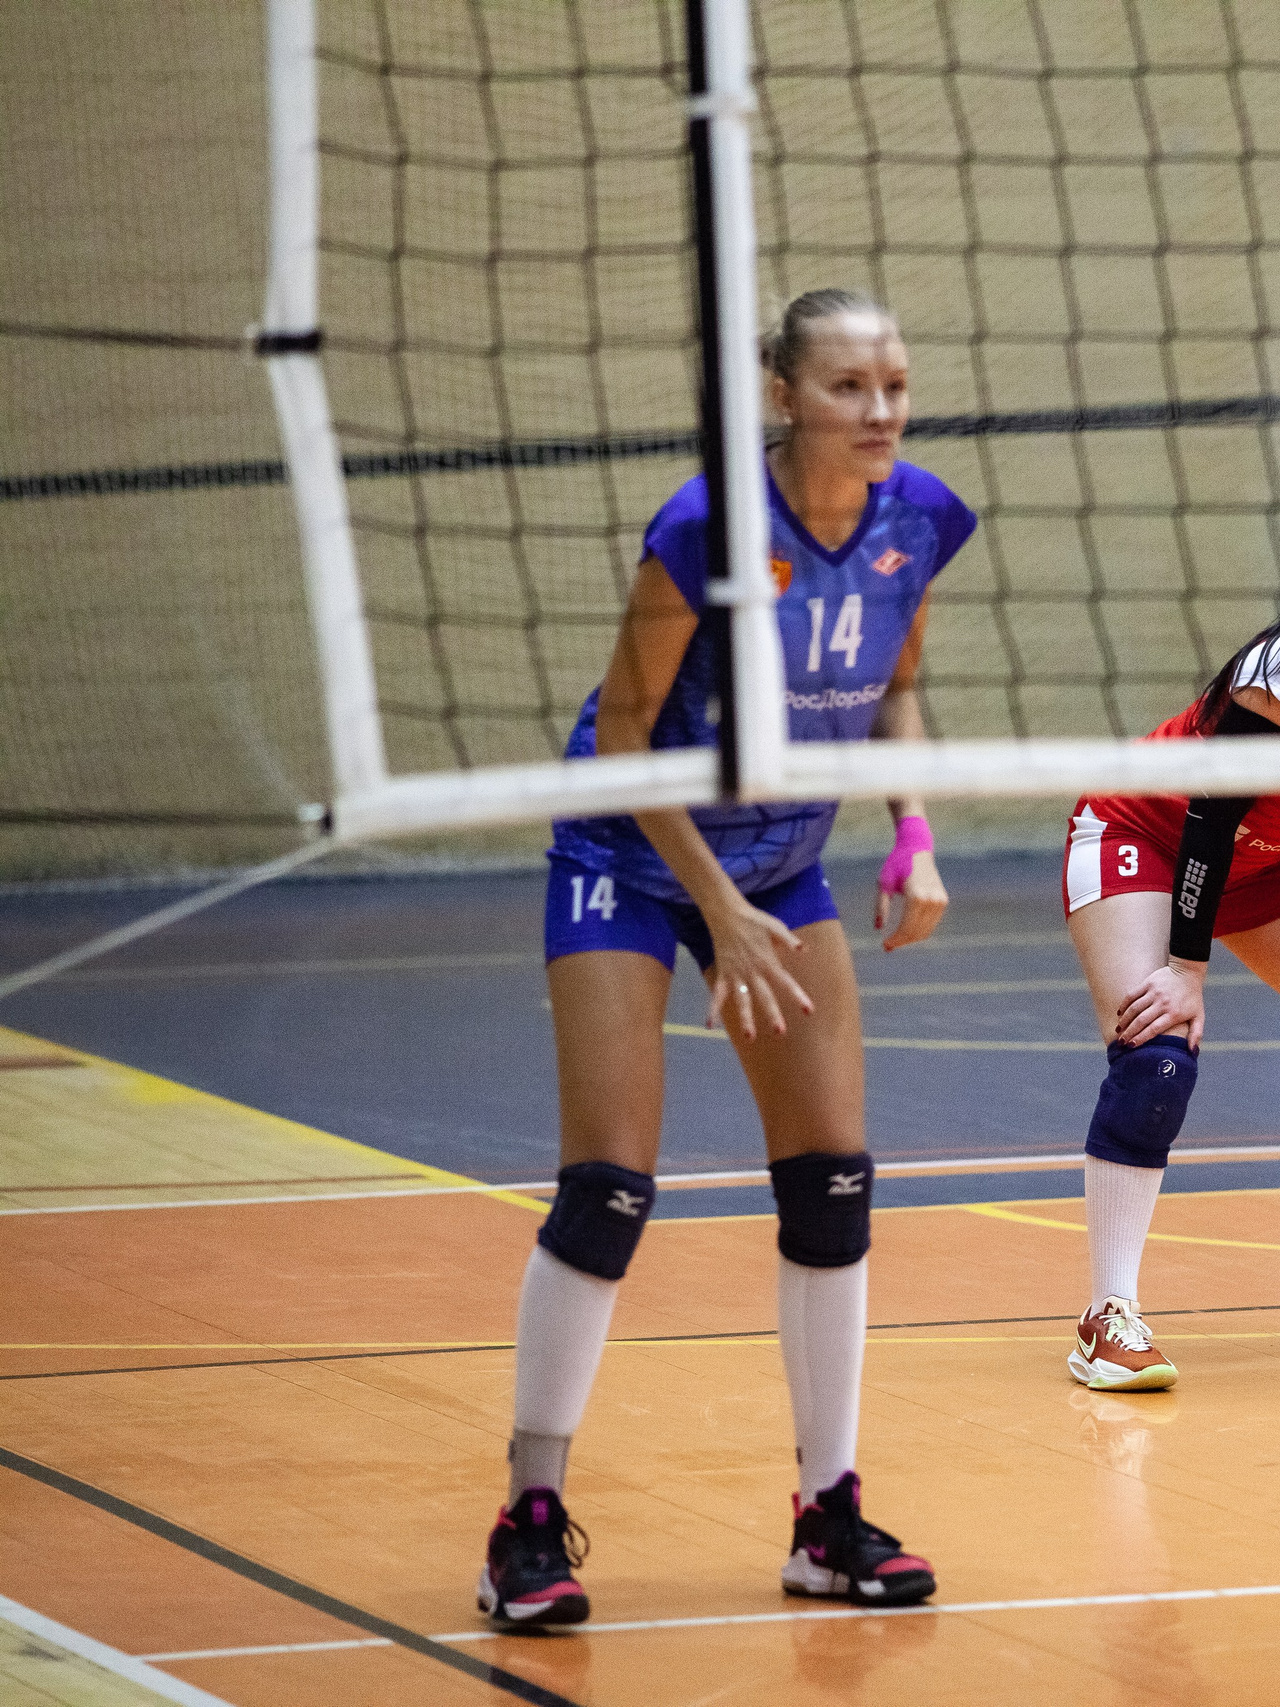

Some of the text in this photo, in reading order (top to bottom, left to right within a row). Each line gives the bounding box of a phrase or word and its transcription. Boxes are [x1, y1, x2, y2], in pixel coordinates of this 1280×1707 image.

[806, 594, 863, 672] 14
[1117, 845, 1139, 876] 3
[570, 875, 618, 923] 14
